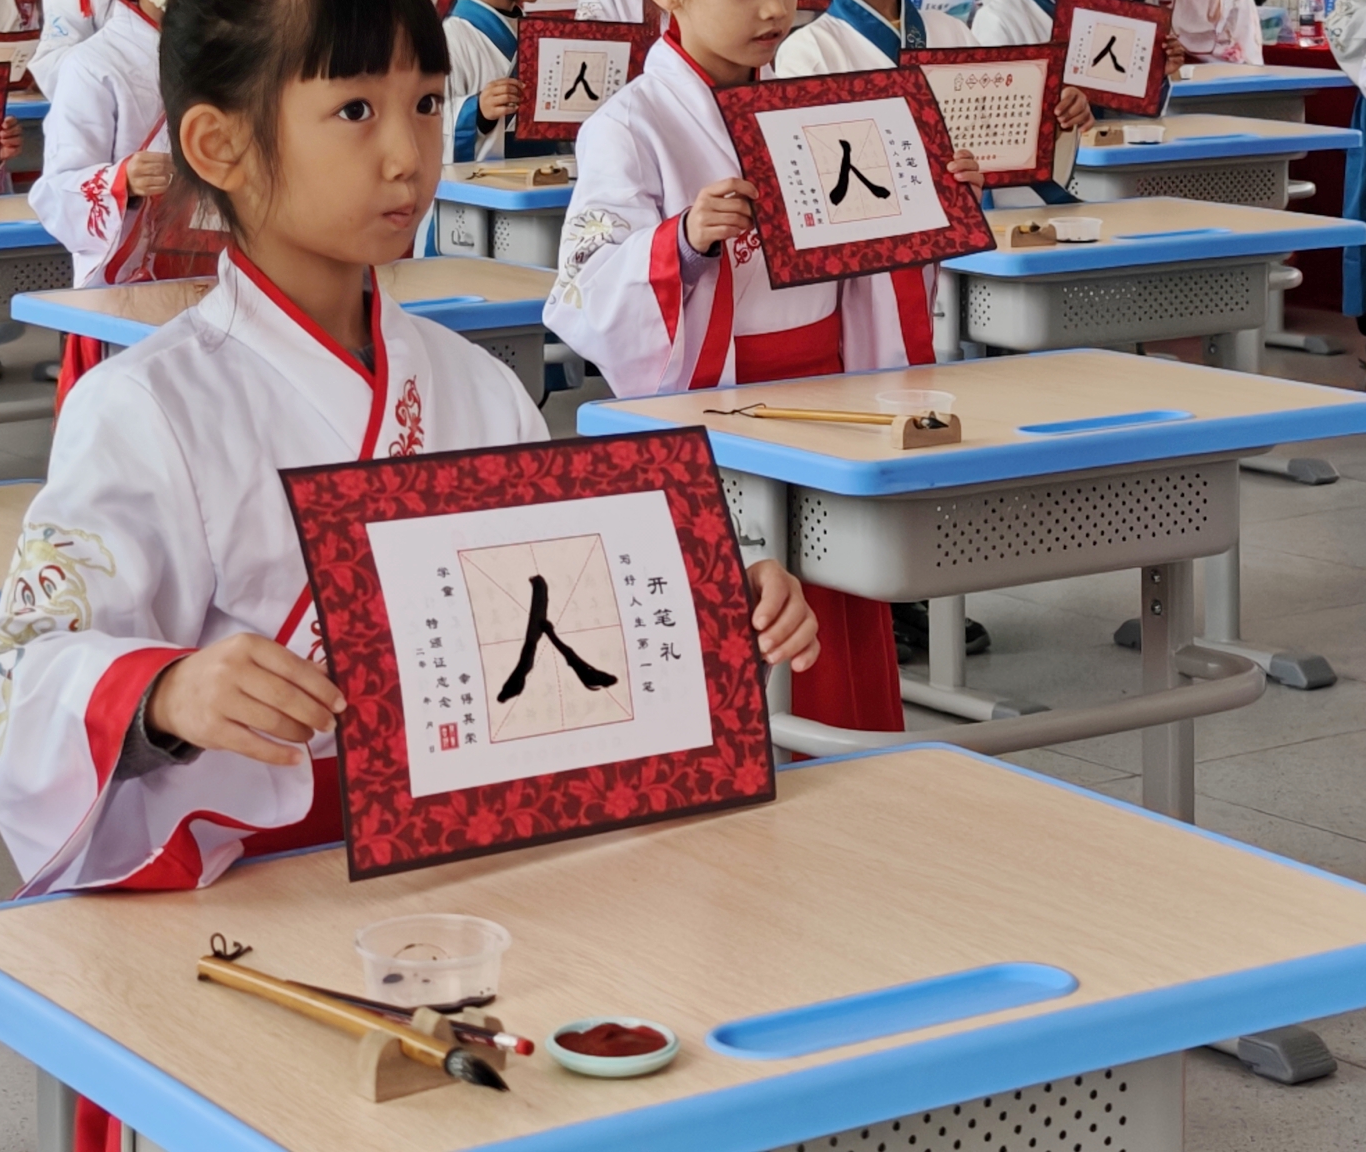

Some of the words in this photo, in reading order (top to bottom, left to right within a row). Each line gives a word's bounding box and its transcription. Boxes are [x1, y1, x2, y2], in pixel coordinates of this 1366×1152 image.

[565, 62, 599, 100] 人
[1092, 36, 1125, 73] 人
[830, 140, 890, 205] 人
[497, 575, 617, 703] 人
[646, 576, 682, 662] 开笔礼
